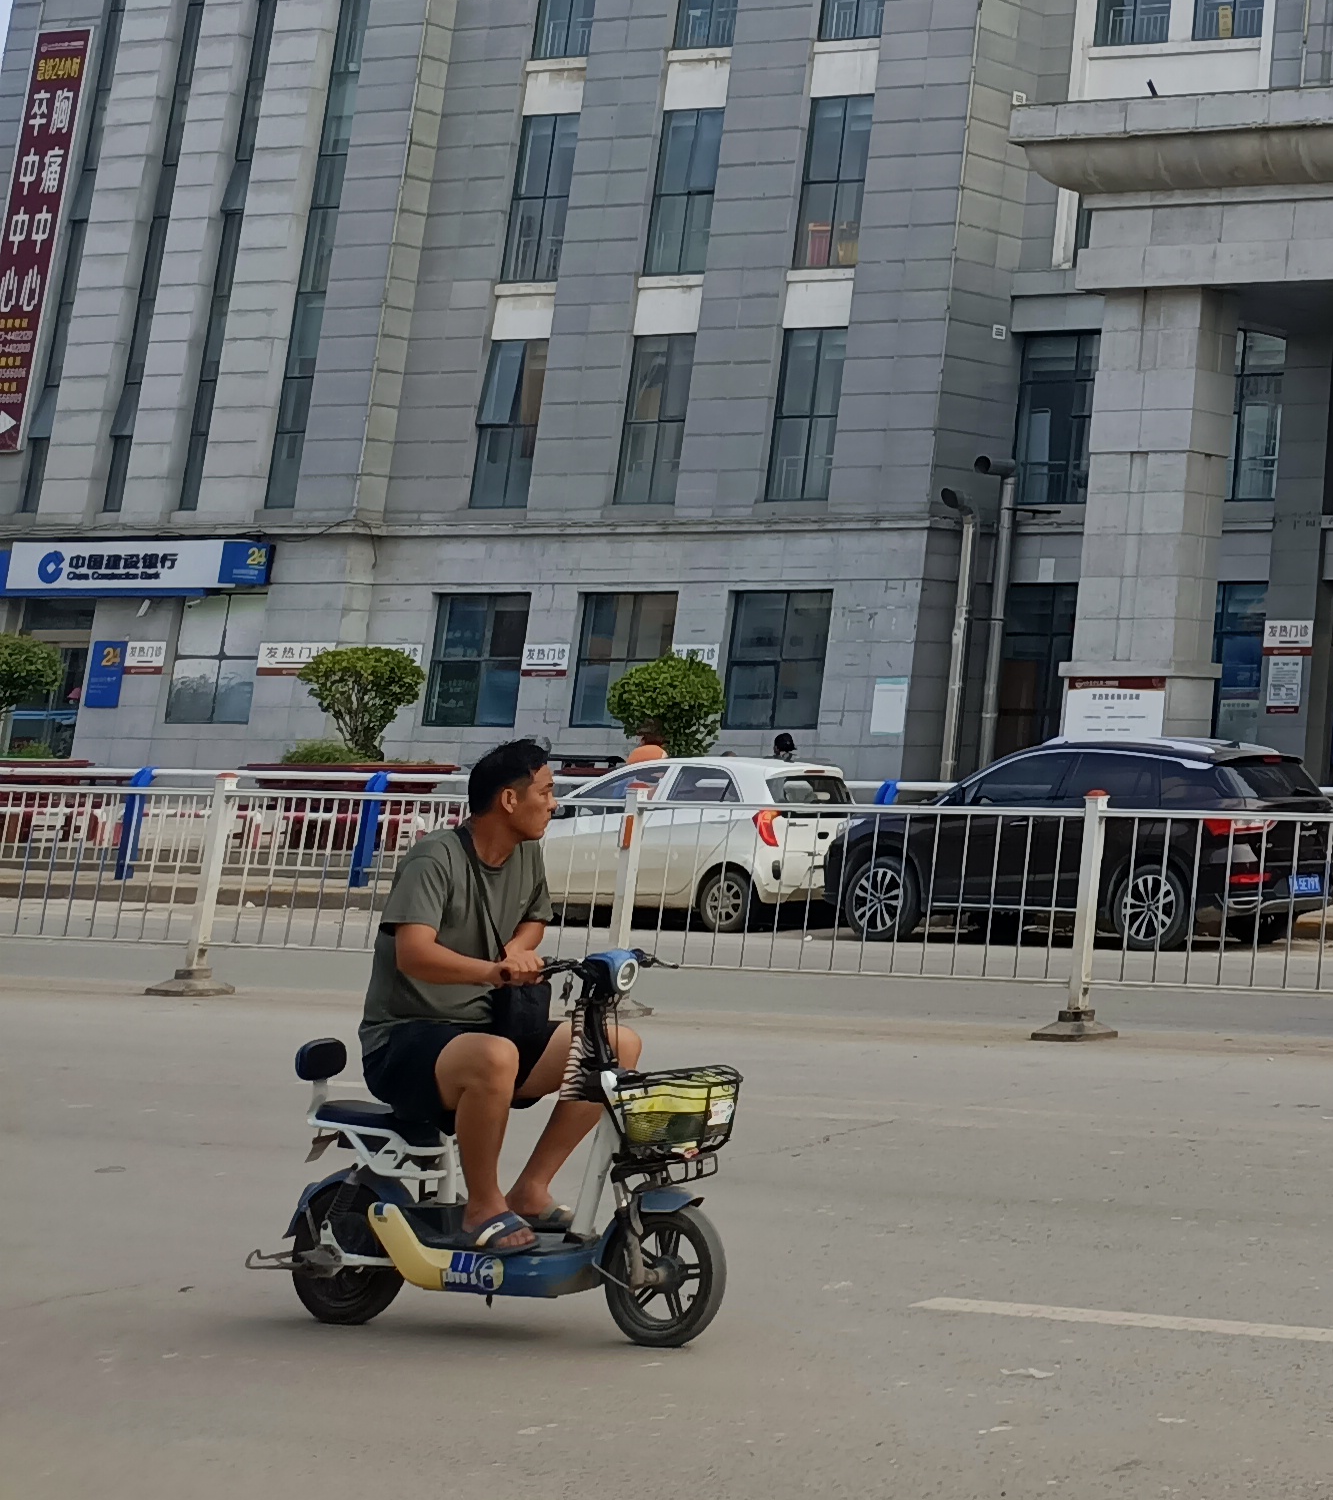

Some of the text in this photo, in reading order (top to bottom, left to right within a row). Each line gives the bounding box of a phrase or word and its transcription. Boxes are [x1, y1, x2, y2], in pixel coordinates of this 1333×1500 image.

[68, 553, 178, 570] 中国建设银行
[246, 547, 267, 566] 24
[1268, 625, 1309, 638] 发热门诊
[101, 647, 121, 666] 24
[128, 646, 163, 658] 发热门诊
[526, 648, 566, 661] 发热门诊
